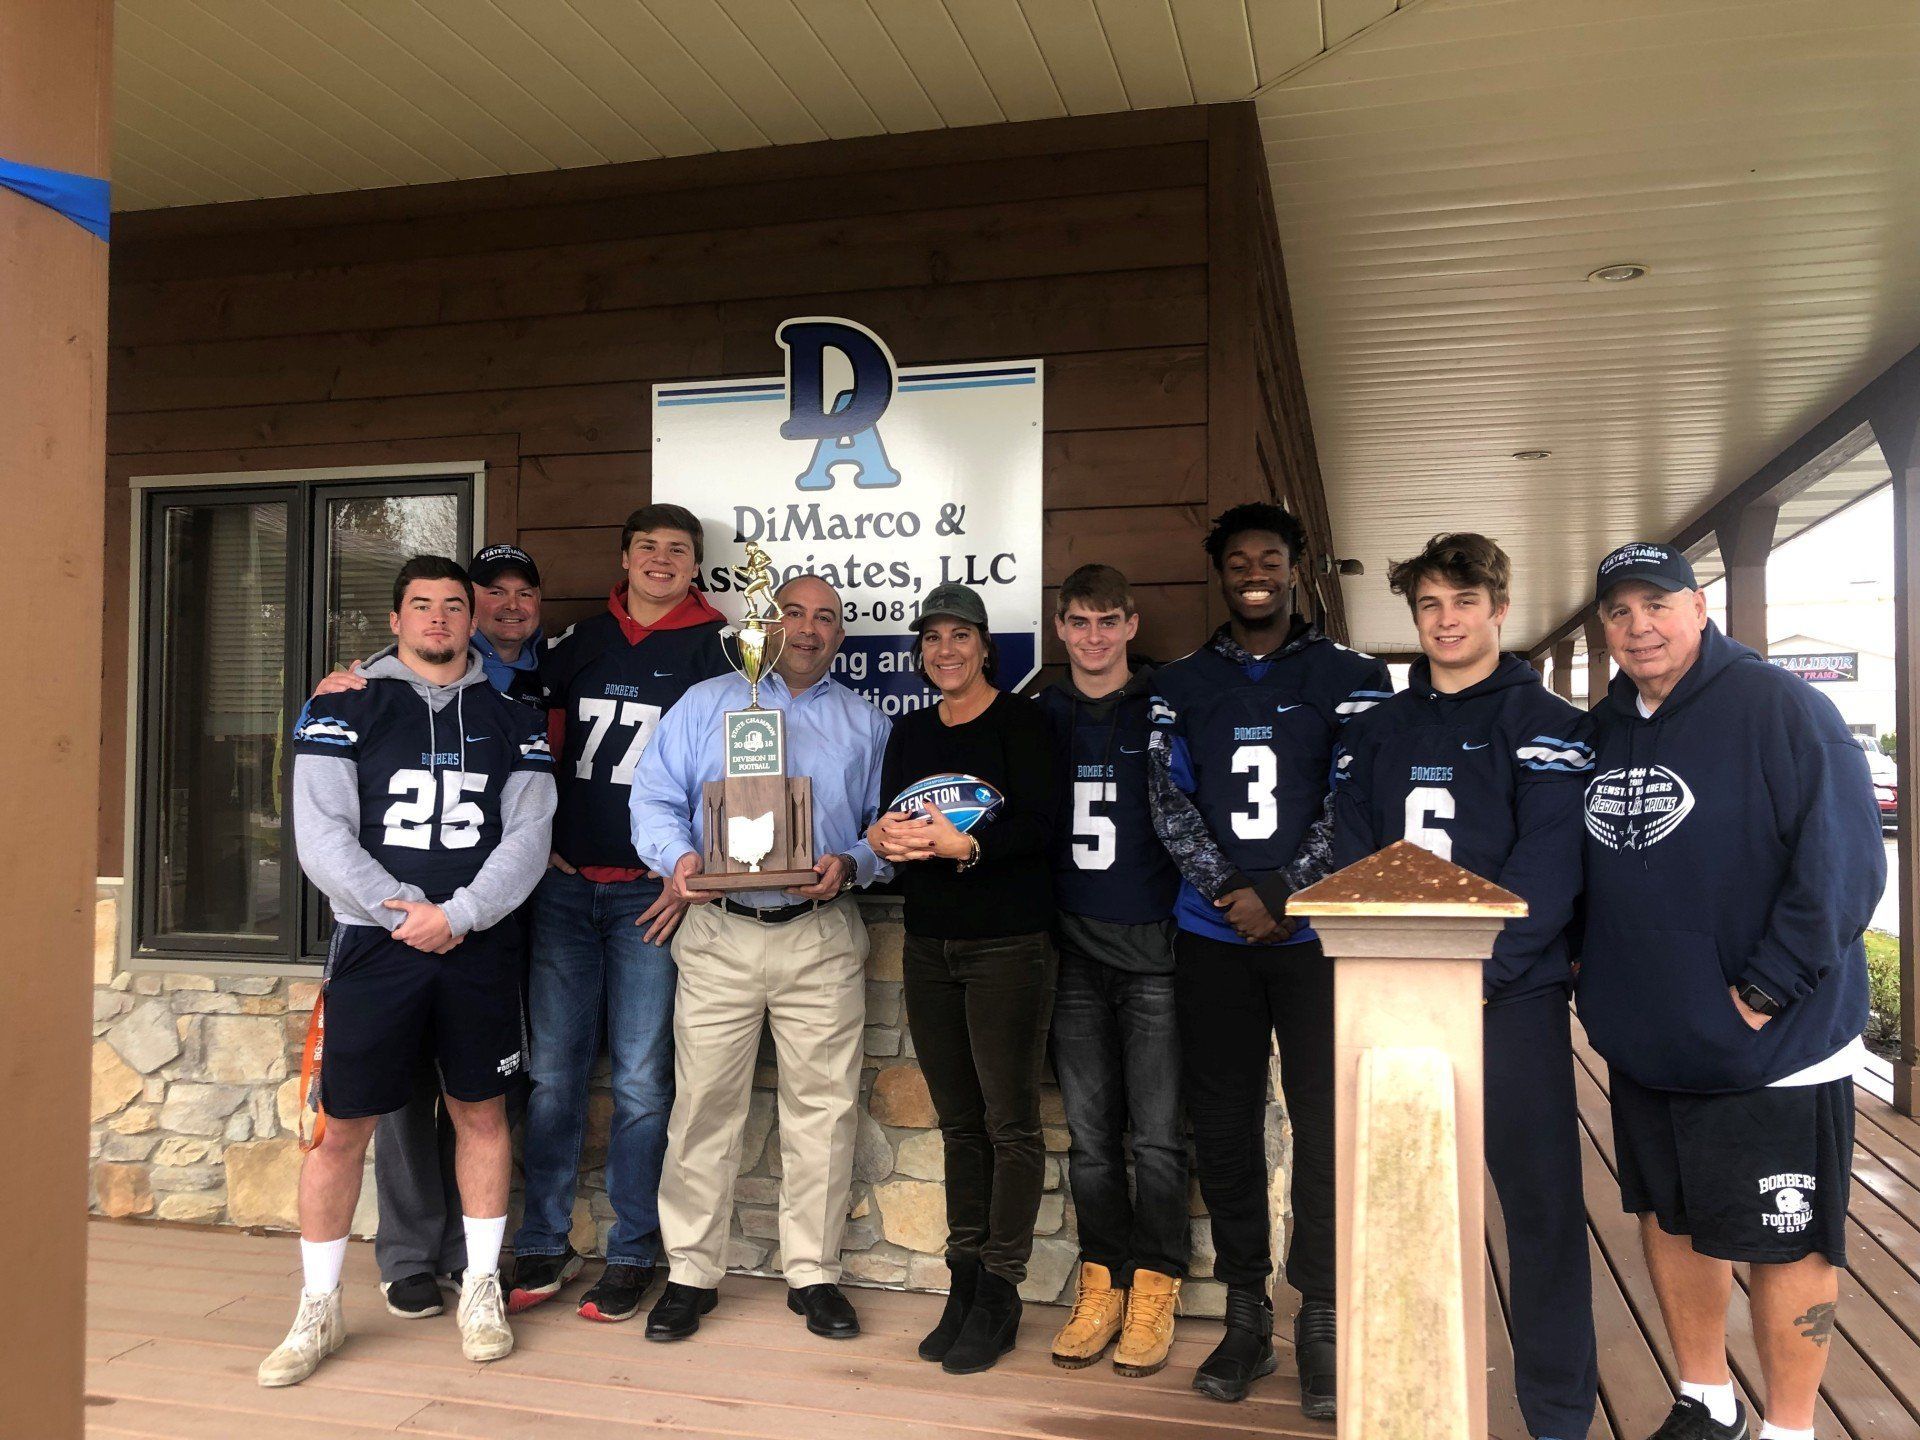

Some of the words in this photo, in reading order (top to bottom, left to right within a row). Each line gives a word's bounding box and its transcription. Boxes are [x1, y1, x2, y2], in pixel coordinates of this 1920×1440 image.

[733, 503, 920, 543] DiMarco
[935, 502, 966, 536] &
[939, 552, 1017, 590] LLC
[1804, 671, 1838, 679] FRAME
[604, 683, 639, 698] BOMBERS
[731, 721, 745, 739] STATE
[745, 718, 776, 737] CHAMPION
[1234, 726, 1273, 741] BOMBERS
[575, 697, 662, 786] 77
[732, 755, 766, 763] DIVISION
[767, 754, 777, 762] III
[738, 763, 771, 771] FOOTBALL
[1410, 766, 1454, 781] BOMBERS
[900, 786, 961, 813] KENSTON
[1231, 745, 1278, 840] 3
[383, 768, 489, 850] 25
[1072, 781, 1117, 871] 5
[1404, 787, 1456, 862] 6
[1759, 1173, 1816, 1195] BOMBERS
[1761, 1210, 1813, 1227] FOOTBALL
[1777, 1224, 1807, 1234] 2017
